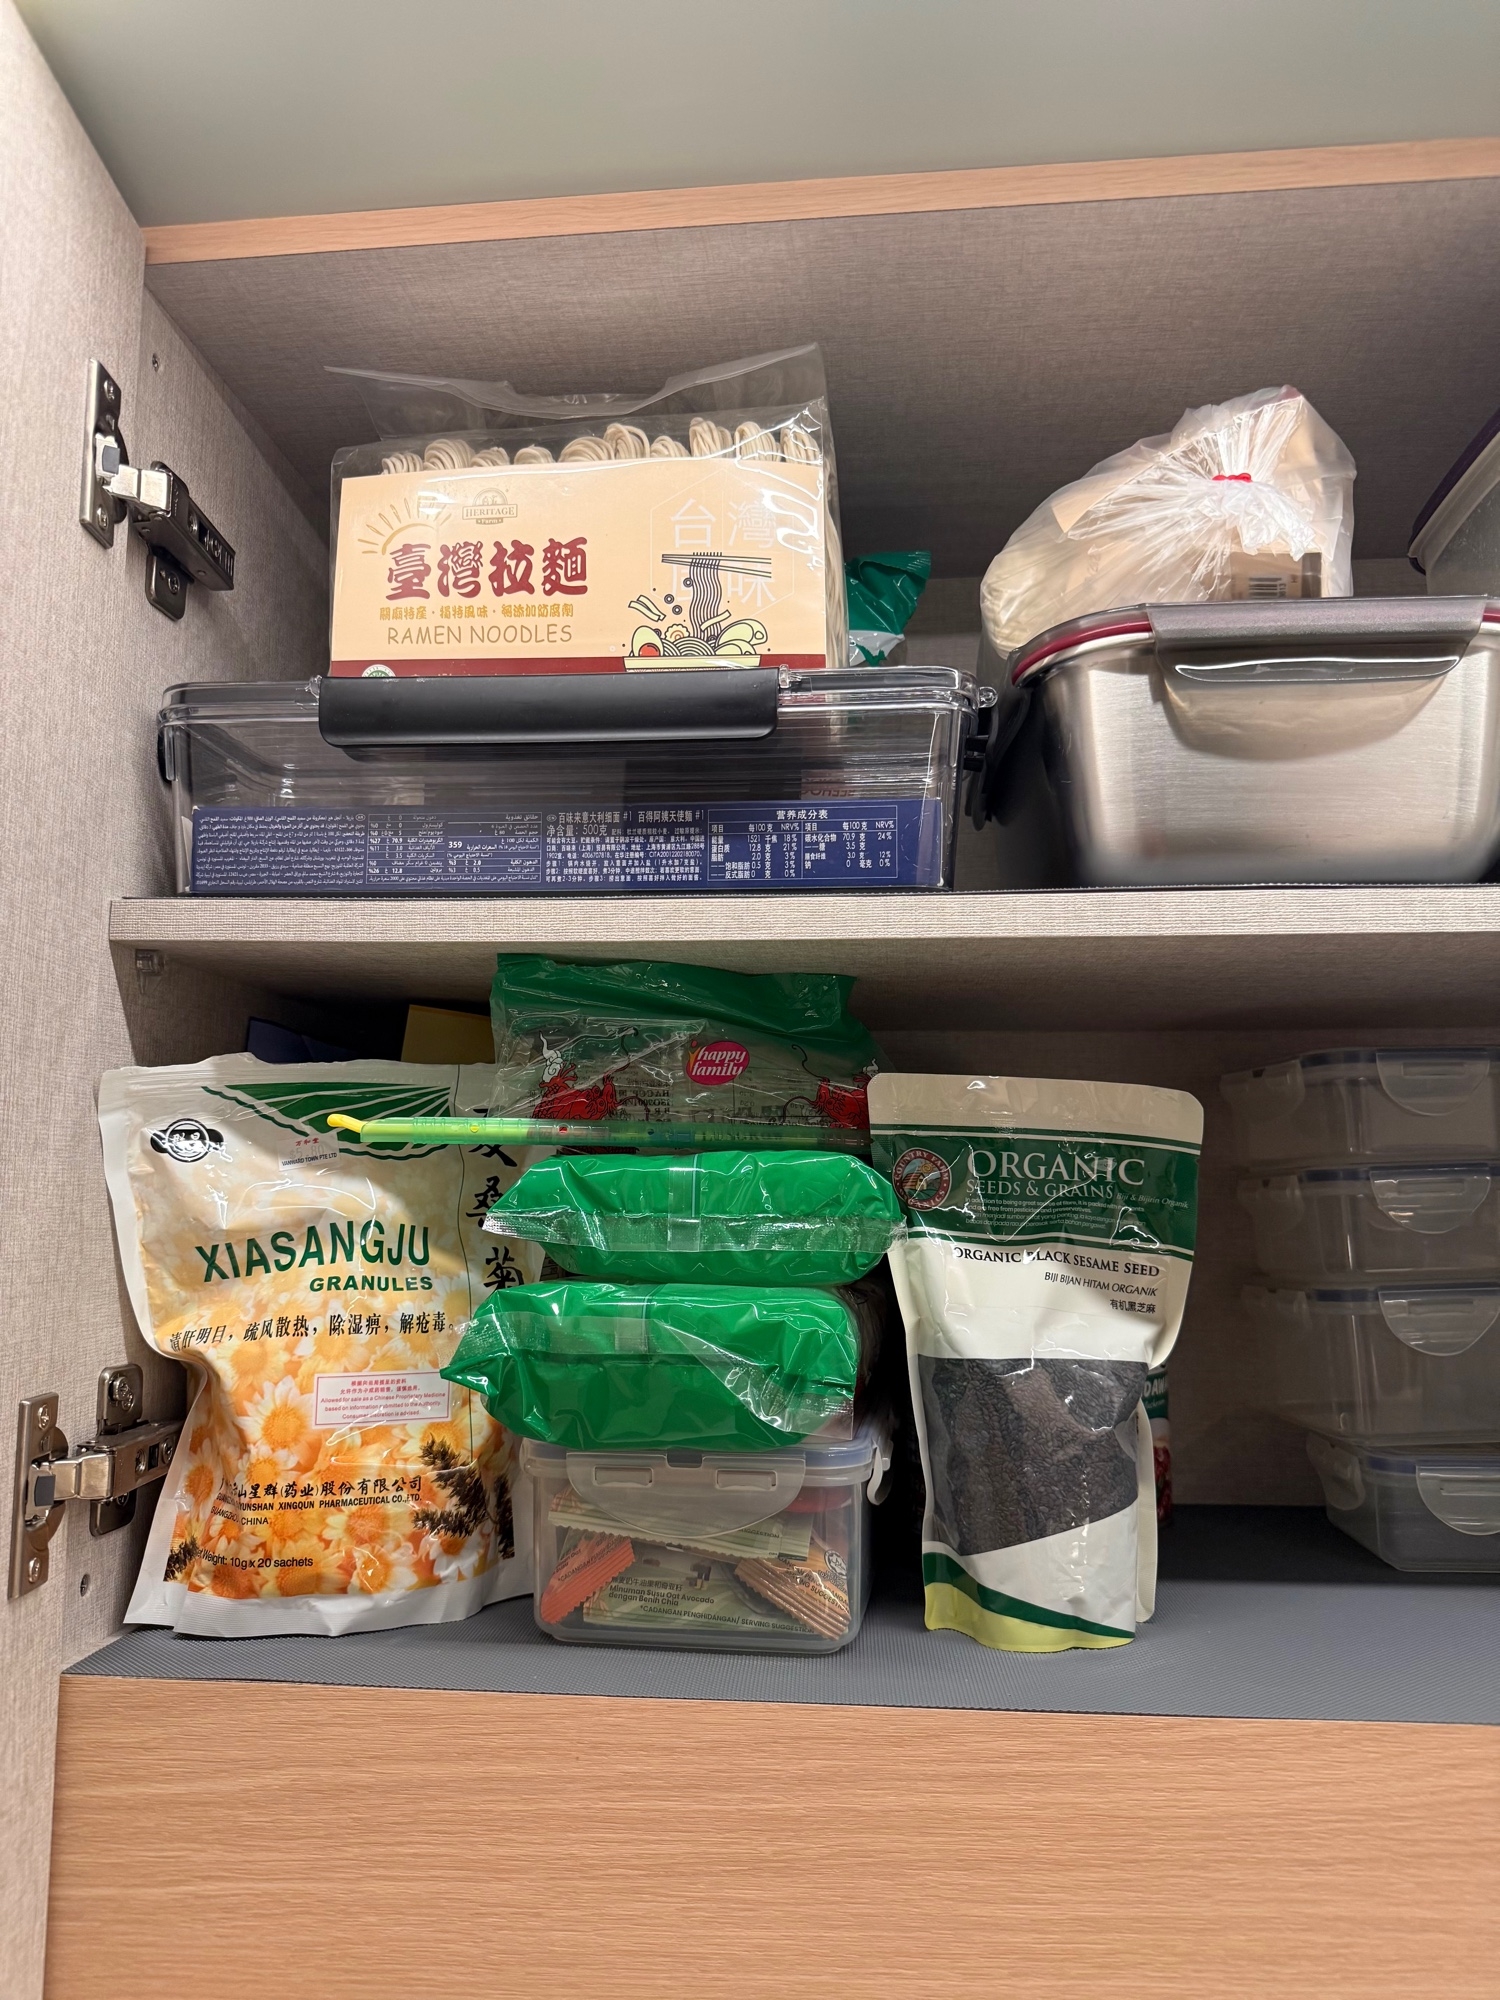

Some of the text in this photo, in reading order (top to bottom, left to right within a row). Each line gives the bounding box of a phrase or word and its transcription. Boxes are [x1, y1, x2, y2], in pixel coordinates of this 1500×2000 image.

[465, 507, 515, 518] HERITAGE
[386, 536, 588, 601] 臺灣拉麵
[387, 623, 573, 645] RAMEN NOODLES
[558, 811, 620, 824] 百味来意大利细面
[776, 809, 828, 820] 营养成分表
[711, 822, 800, 833] 项目 NRV%
[804, 822, 818, 832] 项目
[876, 820, 894, 830] NRV%
[711, 836, 724, 844] 能量
[747, 835, 761, 843] 1521
[764, 835, 778, 844] 千焦
[804, 833, 837, 842] 碳水化合物
[842, 833, 856, 841] 70.9
[860, 833, 866, 842] 克
[448, 841, 463, 849] 359
[711, 844, 730, 853] 蛋白质
[749, 844, 762, 852] 12.8
[765, 844, 771, 852] 克
[846, 842, 855, 850] 3.5
[860, 842, 866, 850] 克
[711, 854, 724, 862] 脂肪
[752, 853, 761, 861] 2.0
[765, 853, 771, 862] 克
[860, 852, 864, 860] 克
[752, 861, 761, 870] 0.5
[765, 862, 771, 870] 克
[859, 860, 872, 868] 毫克
[765, 870, 771, 879] 克
[696, 1046, 746, 1064] happy
[691, 1060, 743, 1077] family
[319, 1154, 328, 1162] PTE
[328, 1152, 338, 1160] LTD
[895, 1150, 928, 1180] COUNTRY
[967, 1150, 1145, 1186] ORGANIC
[966, 1179, 1113, 1199] SEEDS & GRAINS
[194, 1219, 430, 1283] XIASANGJU
[954, 1247, 1160, 1277] ORGANIC BLACK SESAME SEED
[309, 1275, 433, 1292] GRANULES
[1044, 1271, 1159, 1297] BIJI BIJAN HITAM ORGANIK
[1110, 1299, 1156, 1315] 有机黑芝麻
[325, 1404, 341, 1412] based
[278, 1500, 314, 1510] XINGQUN
[319, 1496, 390, 1509] PHARMACEUTICAL
[241, 1516, 269, 1526] CHINA
[230, 1557, 248, 1570] 10g
[258, 1558, 272, 1568] 20
[273, 1556, 314, 1568] sachets
[608, 1592, 679, 1606] dengan Benih Chia
[609, 1584, 715, 1605] Minuman Susu Oat Avocado
[741, 1618, 770, 1628] SERVING
